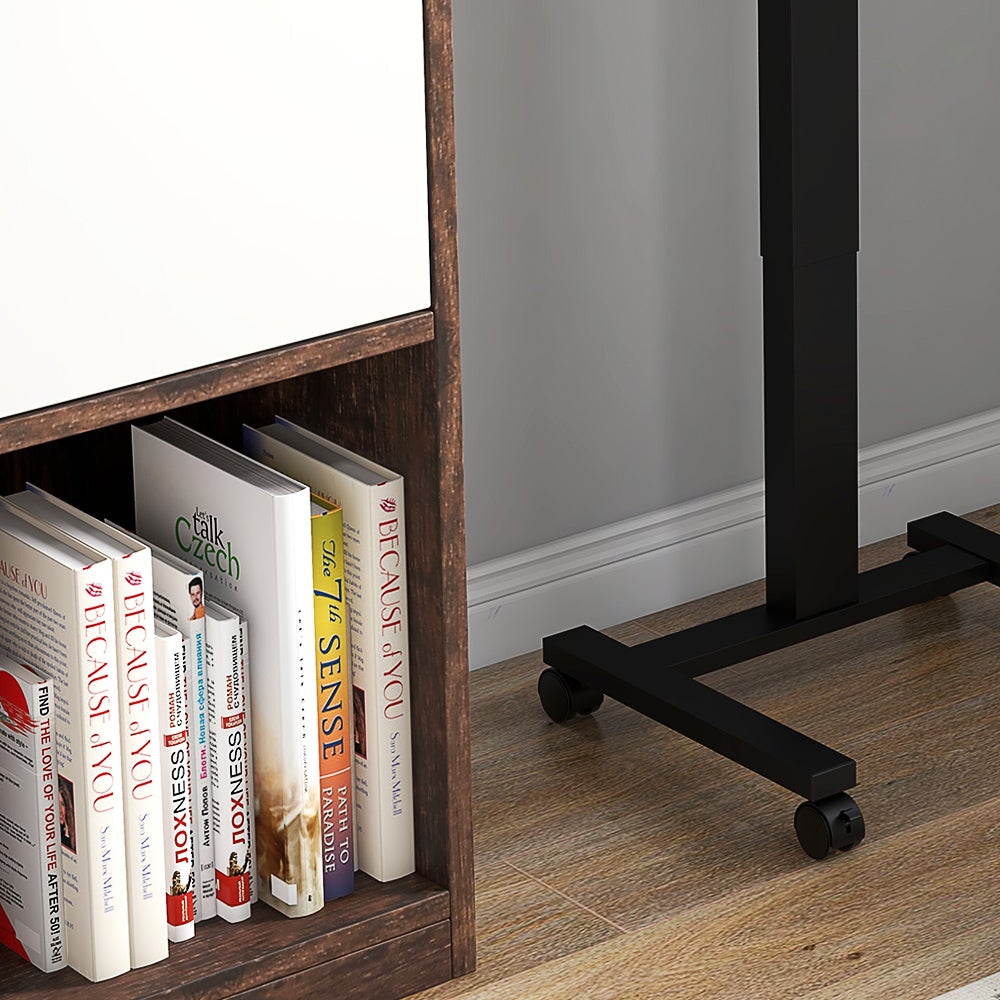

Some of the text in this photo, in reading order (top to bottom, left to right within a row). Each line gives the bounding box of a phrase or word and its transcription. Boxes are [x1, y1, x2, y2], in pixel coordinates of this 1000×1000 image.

[175, 516, 240, 580] Czech
[193, 512, 225, 550] talk
[322, 539, 336, 577] The
[379, 518, 404, 720] BECAUSE of YOU
[38, 685, 50, 717] FIND
[84, 603, 114, 813] BECAUSE of YOU
[124, 592, 153, 800] BECAUSE of YOU
[168, 692, 176, 728] РОМАН
[226, 674, 234, 710] РОМАН
[319, 634, 344, 760] SENSE
[40, 718, 51, 745] THE
[196, 633, 210, 847] Антон Попов Блоги. Новая сфера влияния
[41, 746, 53, 782] LOVE
[43, 786, 54, 801] OF
[44, 803, 55, 842] YOUR
[322, 787, 336, 872] PARADISE
[338, 785, 349, 864] PATH TO
[46, 843, 57, 871] LIFE
[47, 873, 60, 916] AFTER
[50, 916, 61, 936] 50!
